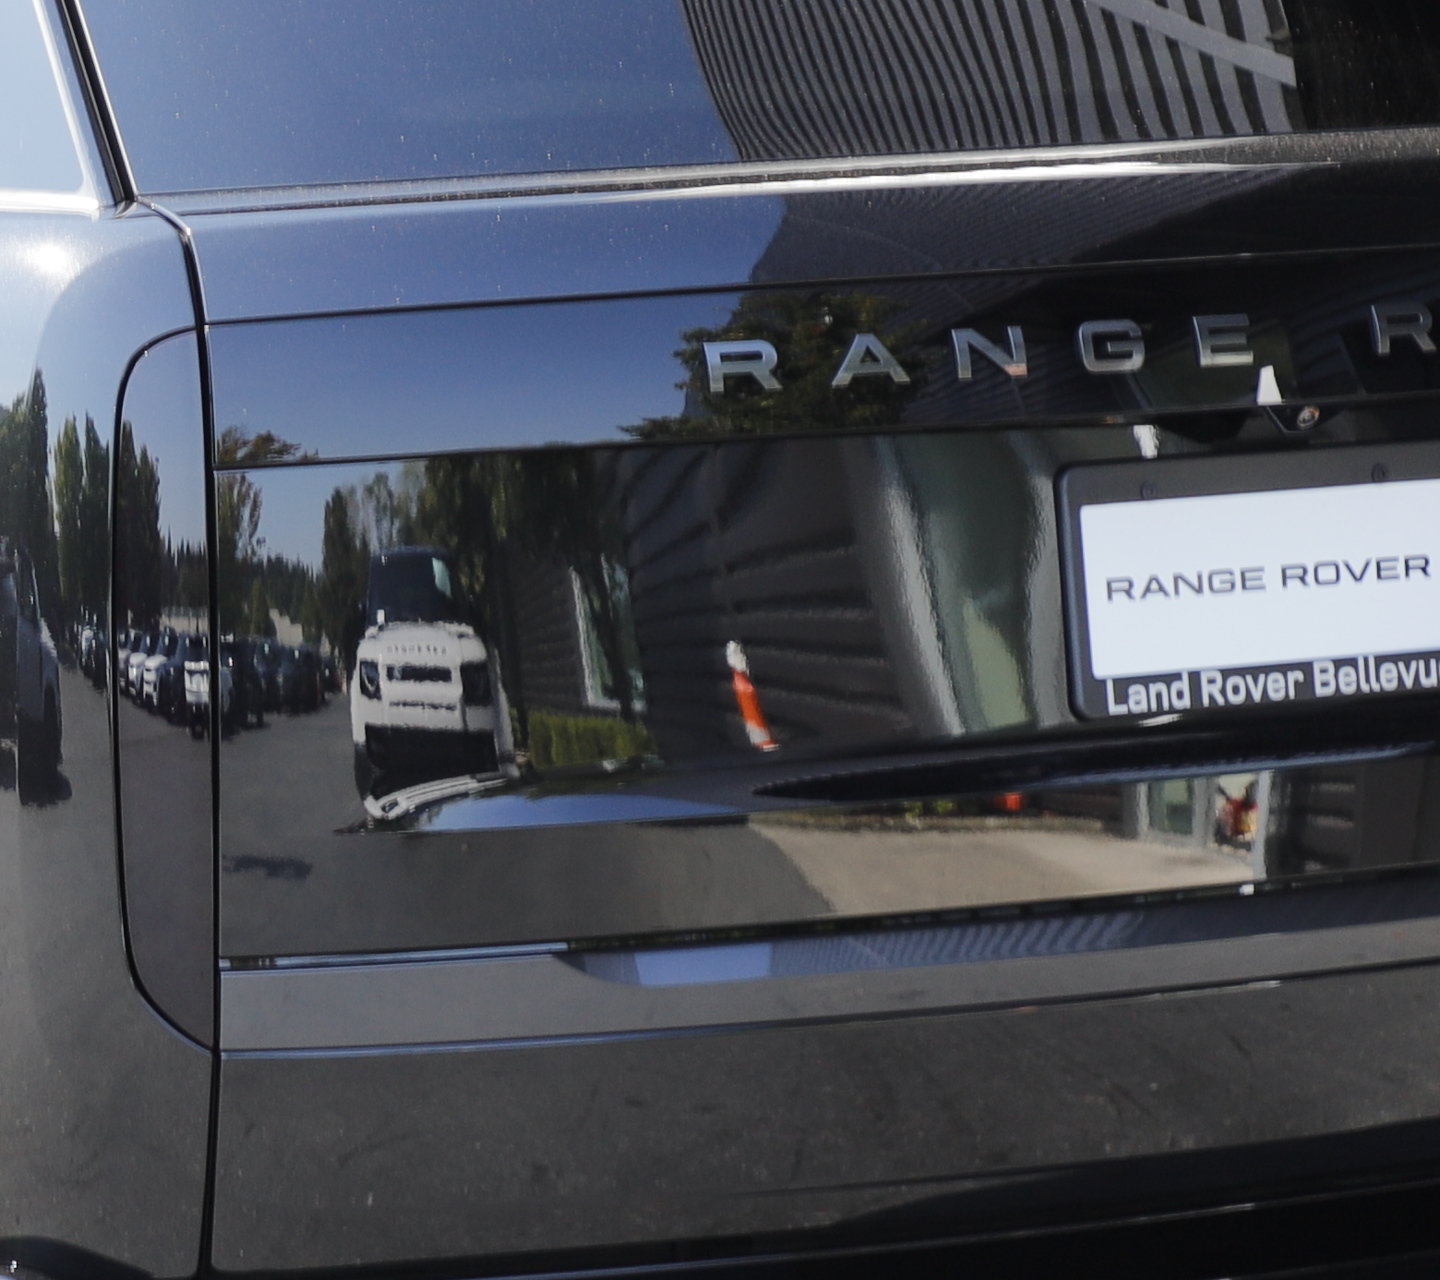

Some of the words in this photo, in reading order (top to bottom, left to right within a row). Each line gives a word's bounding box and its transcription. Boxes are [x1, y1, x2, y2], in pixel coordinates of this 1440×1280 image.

[703, 313, 1255, 393] RANGE
[1105, 565, 1266, 604] RANGE
[1280, 553, 1432, 589] ROVER
[1105, 670, 1192, 715] Land
[1199, 666, 1305, 708] Rover
